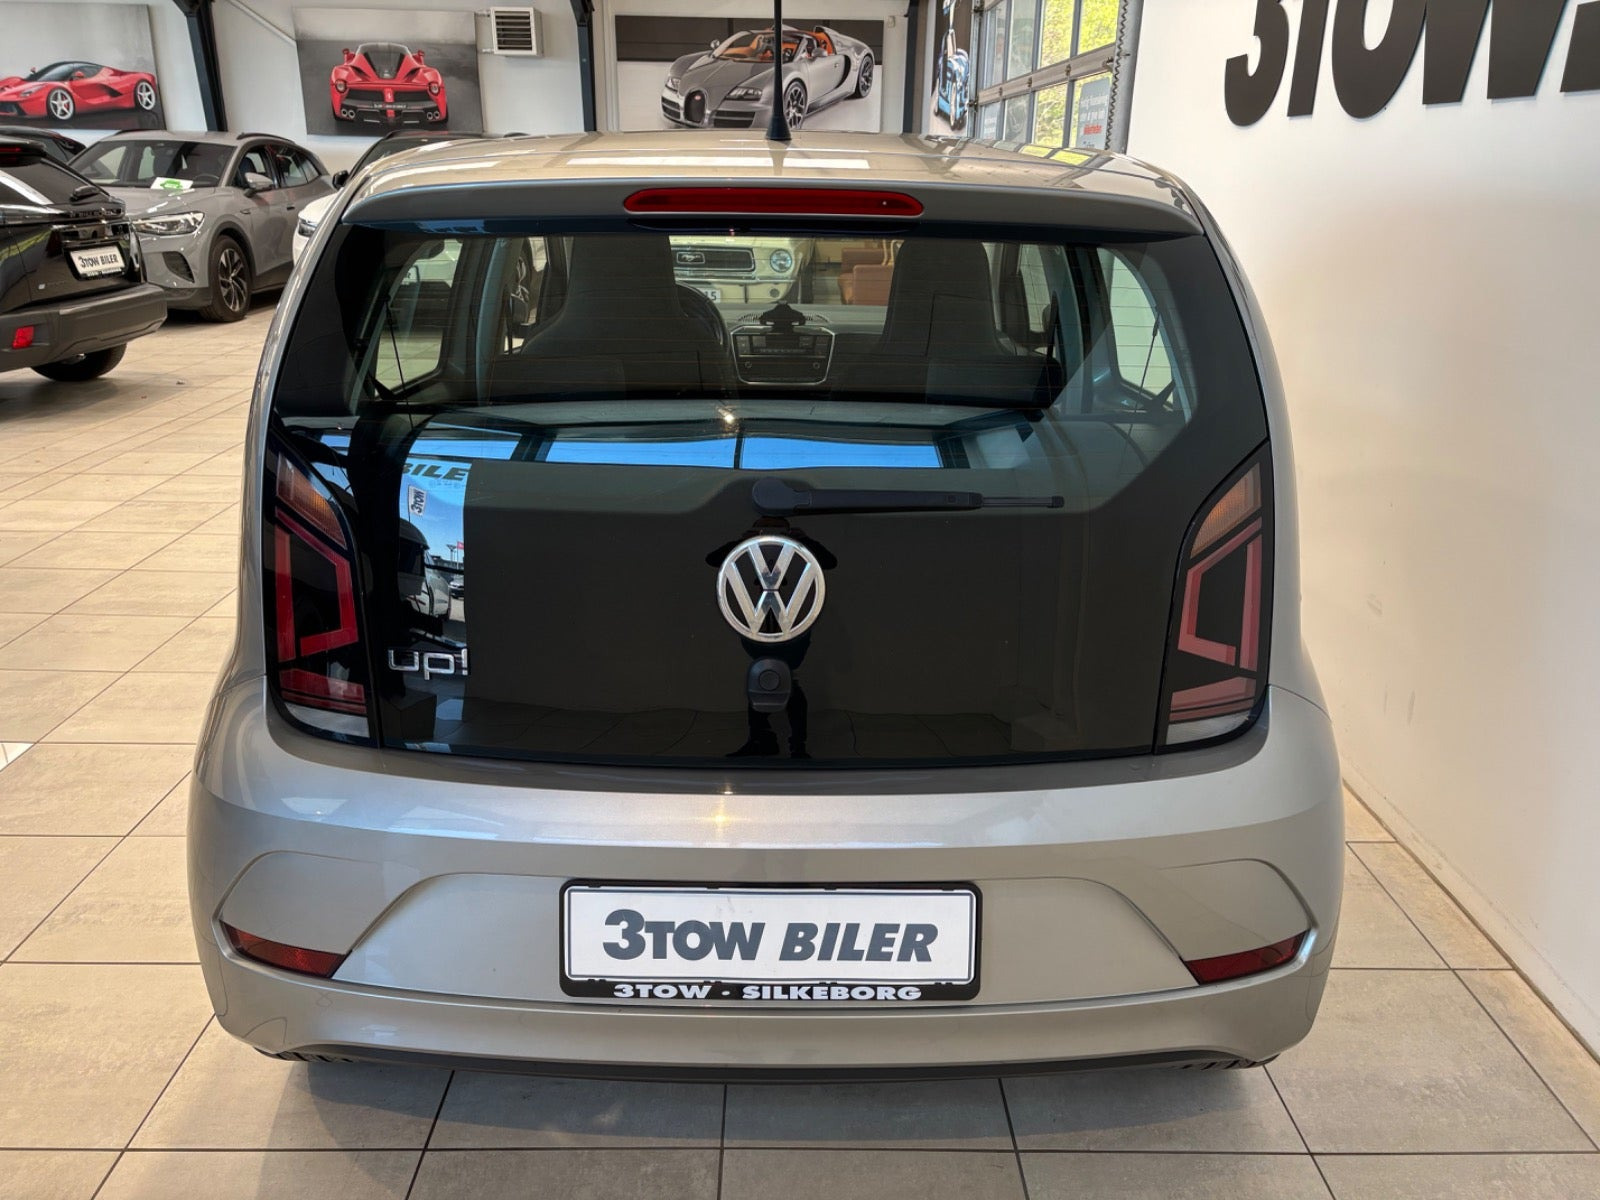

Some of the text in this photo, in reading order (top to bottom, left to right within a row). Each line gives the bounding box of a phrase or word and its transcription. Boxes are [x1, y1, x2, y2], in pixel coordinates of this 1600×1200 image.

[388, 648, 468, 681] up!
[602, 908, 939, 963] 3TOW BILER
[613, 983, 922, 1001] 3TOW SILKEBORG
